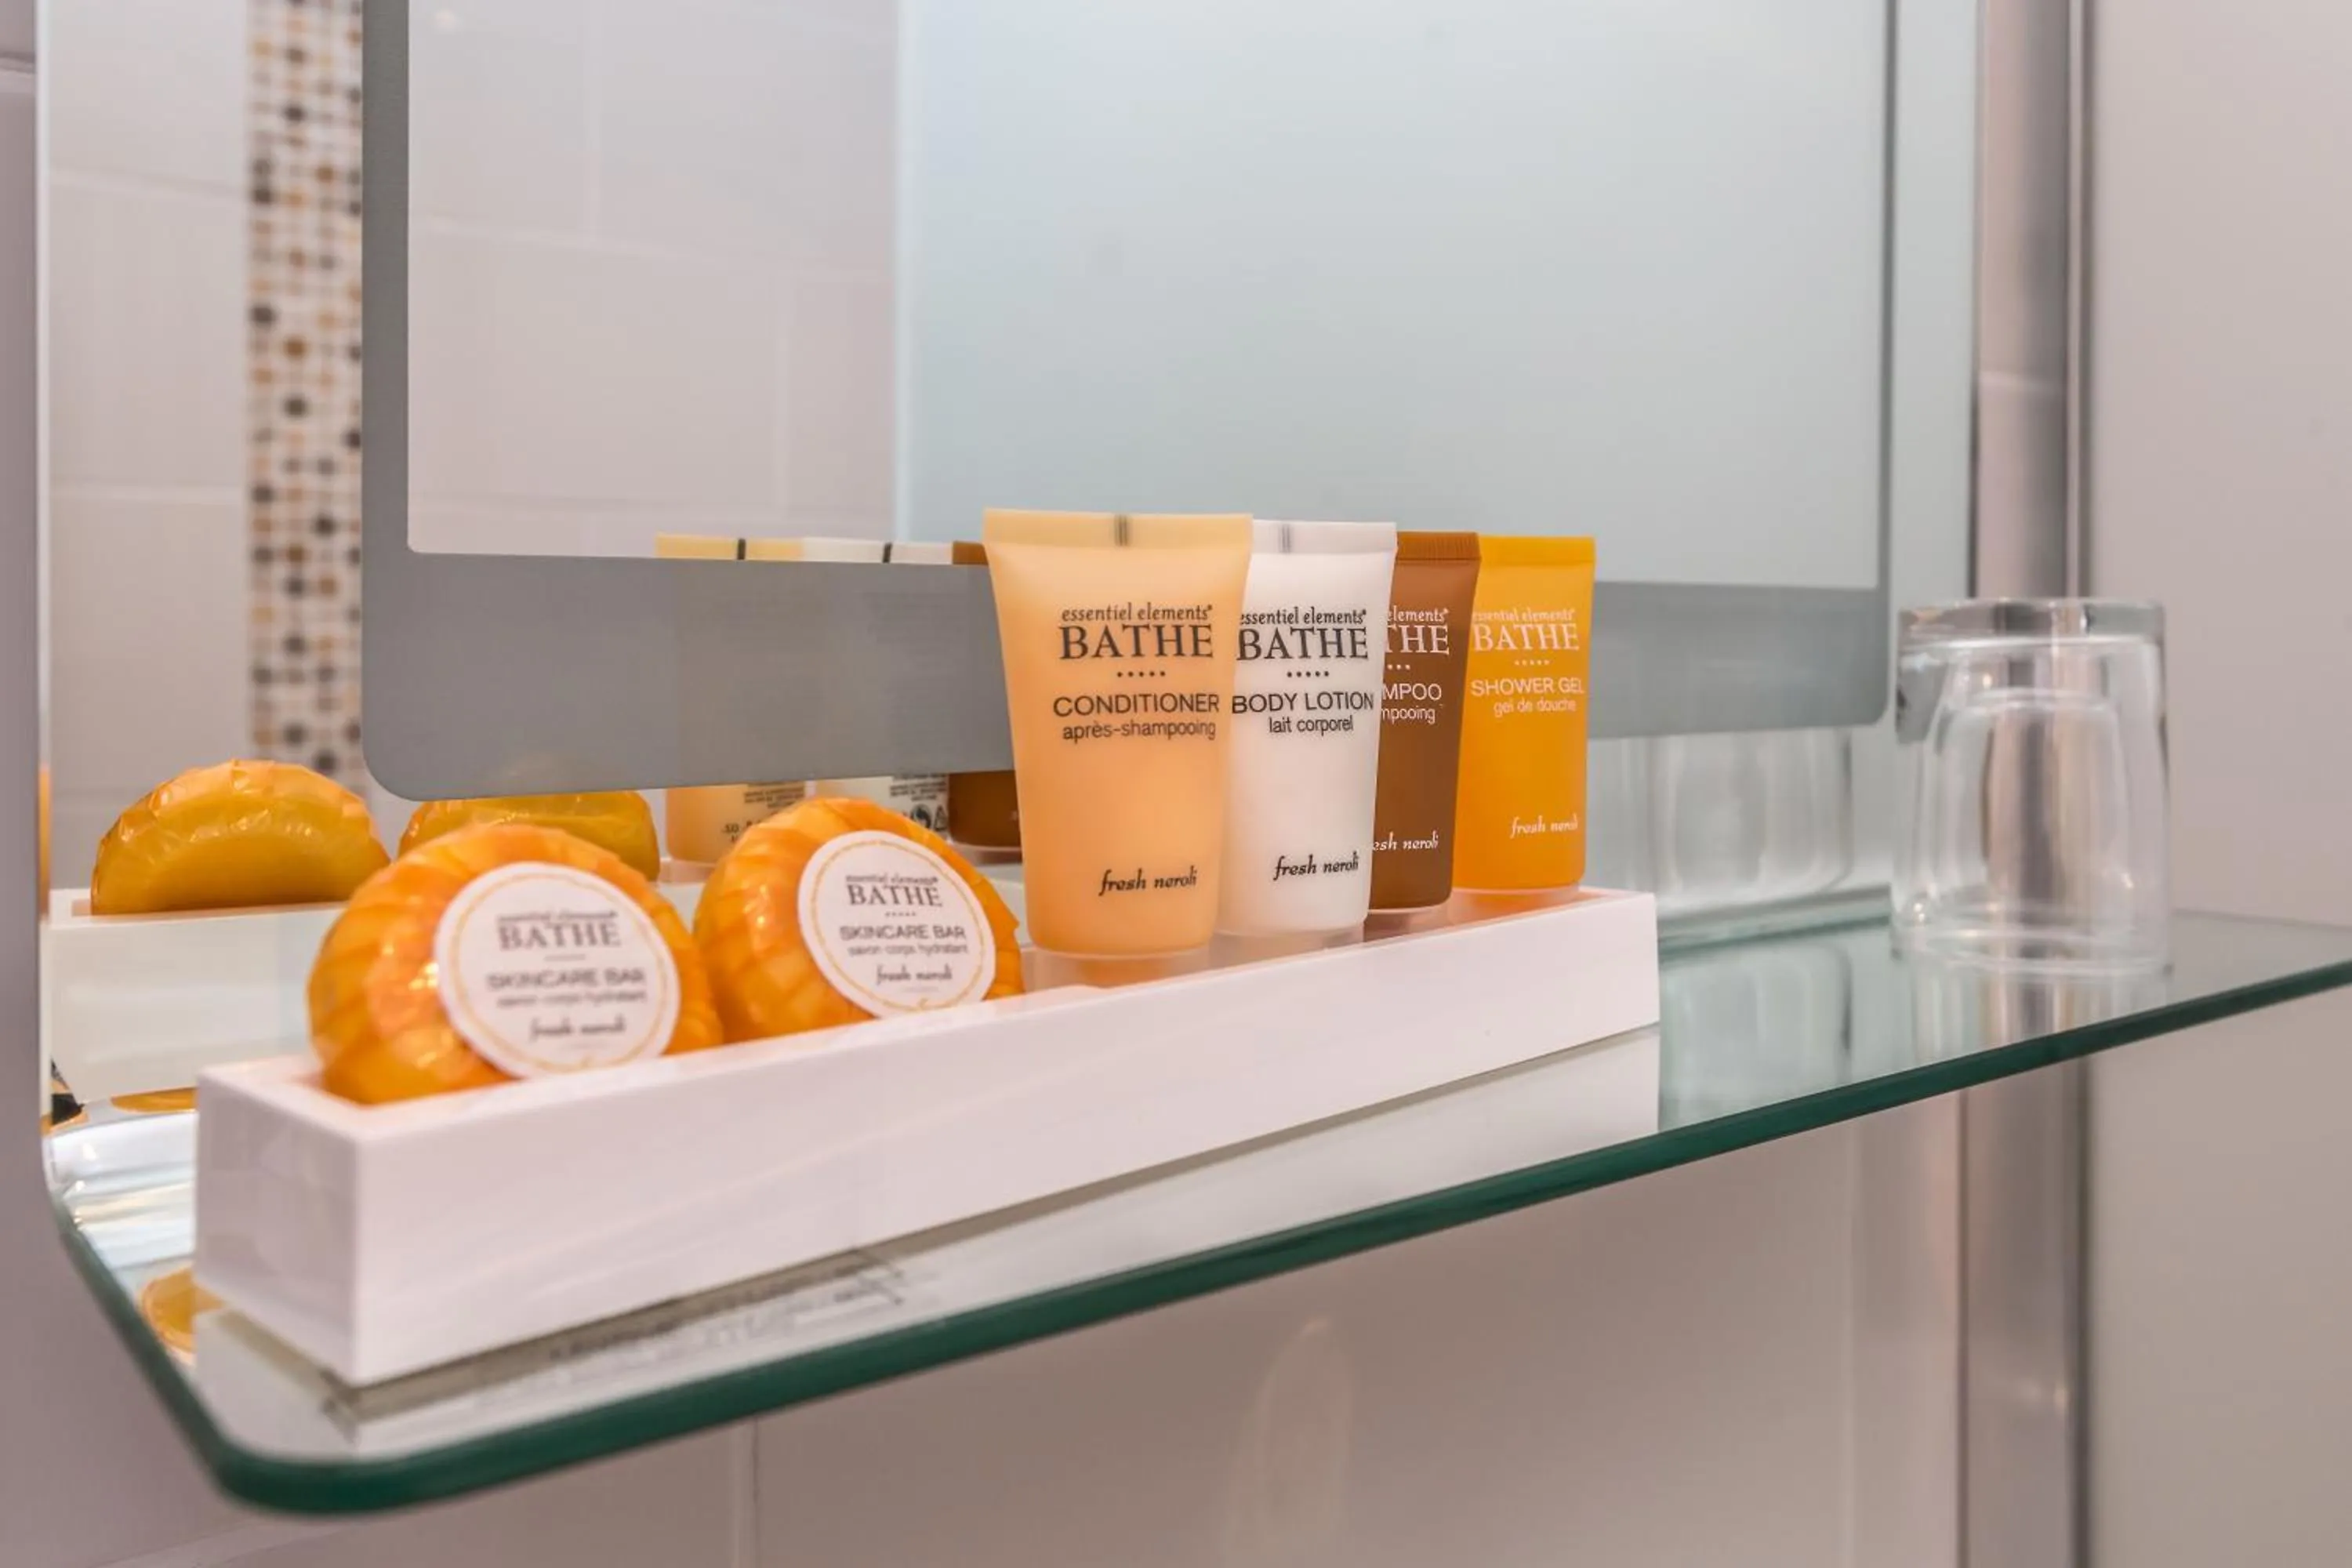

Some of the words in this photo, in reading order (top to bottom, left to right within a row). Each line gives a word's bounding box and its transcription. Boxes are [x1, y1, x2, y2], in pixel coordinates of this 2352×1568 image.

[1061, 601, 1132, 622] essentiel
[1058, 624, 1214, 659] BATHE
[1236, 626, 1369, 660] BATHE
[1385, 624, 1450, 655] THE
[1472, 623, 1581, 652] BATHE
[1382, 683, 1442, 702] MPOO
[1470, 679, 1555, 698] SHOWER
[1558, 677, 1584, 694] GEL
[1053, 693, 1219, 717] CONDITIONER
[1232, 693, 1298, 714] BODY
[1305, 691, 1374, 710] LOTION
[1062, 718, 1216, 744] après-shampooing
[1269, 717, 1292, 733] lait
[1297, 715, 1353, 736] corporel
[1509, 815, 1546, 839] fresh
[1403, 829, 1439, 851] neroli
[1272, 854, 1318, 881] fresh
[1323, 850, 1359, 873] neroli
[1098, 868, 1147, 897] fresh
[1153, 865, 1197, 890] neroli
[846, 884, 942, 906] BATHE
[499, 922, 621, 950] BATHE
[840, 925, 928, 941] SKINCARE
[933, 924, 967, 939] BAR
